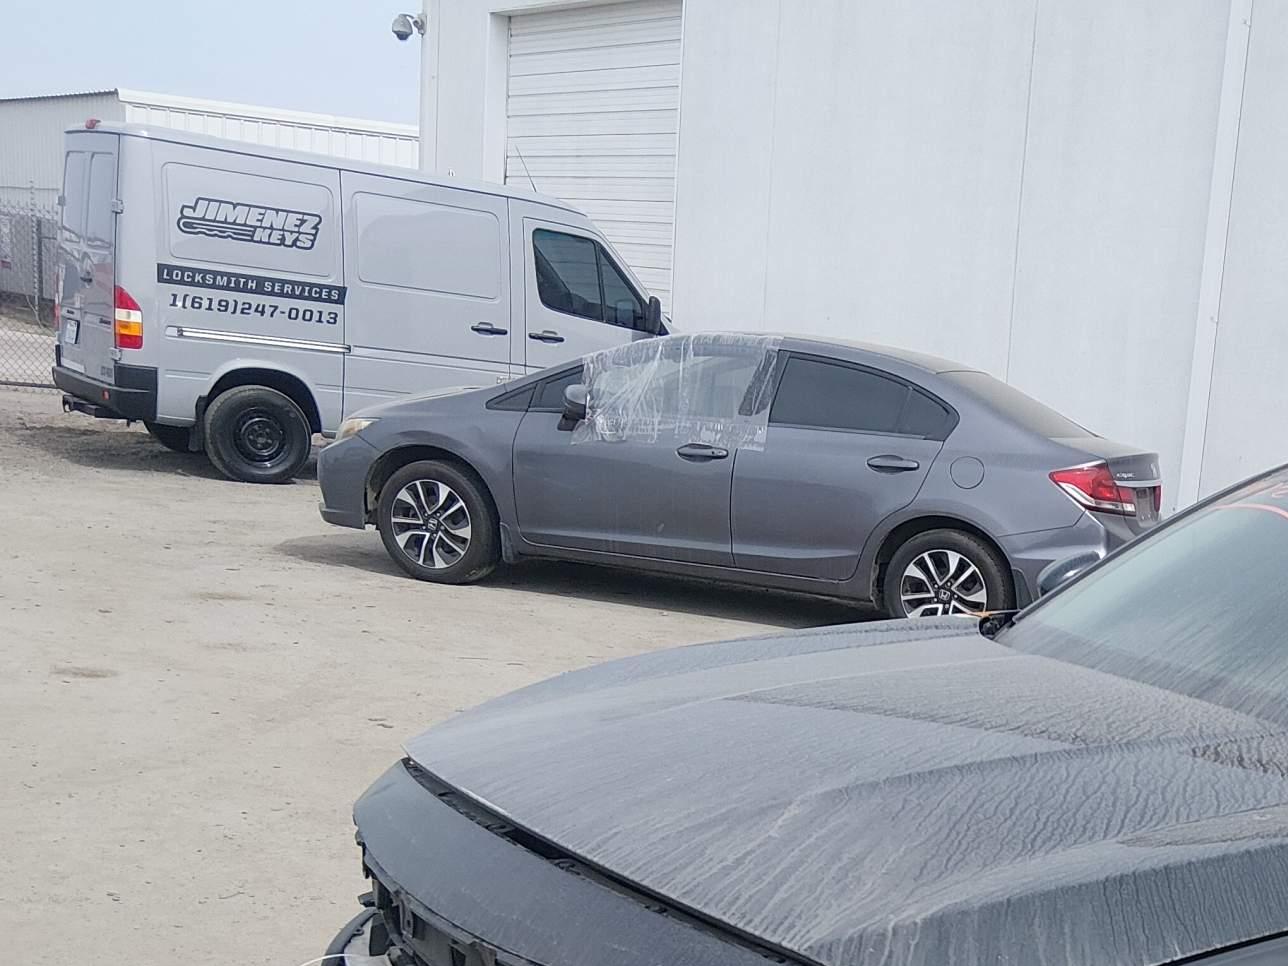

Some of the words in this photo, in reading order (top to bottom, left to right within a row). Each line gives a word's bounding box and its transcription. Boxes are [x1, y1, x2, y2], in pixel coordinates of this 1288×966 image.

[181, 197, 321, 235] JIMENEZ
[252, 227, 316, 249] KEYS
[162, 268, 258, 291] LOCKSMITH
[263, 280, 341, 301] SERVICES
[168, 292, 340, 326] 1(619)247-0013
